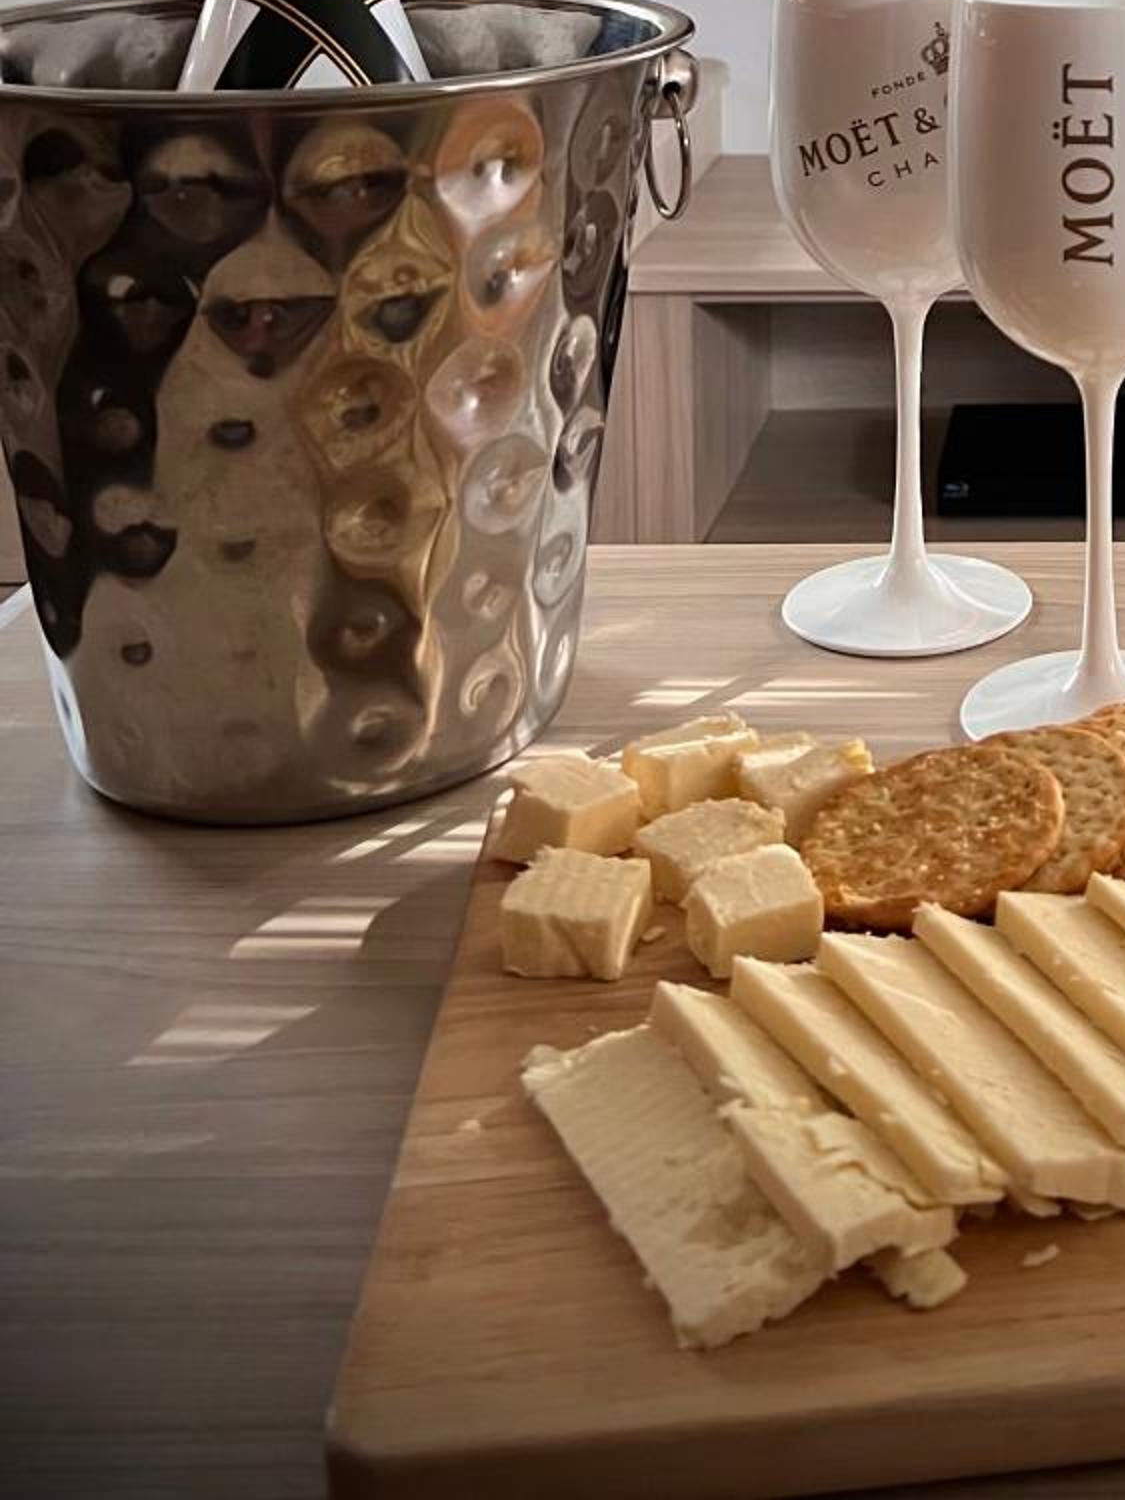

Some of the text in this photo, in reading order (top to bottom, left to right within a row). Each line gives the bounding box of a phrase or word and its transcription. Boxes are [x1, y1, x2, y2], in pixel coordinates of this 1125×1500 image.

[798, 107, 942, 177] MOËT &
[1053, 63, 1114, 266] MOËT
